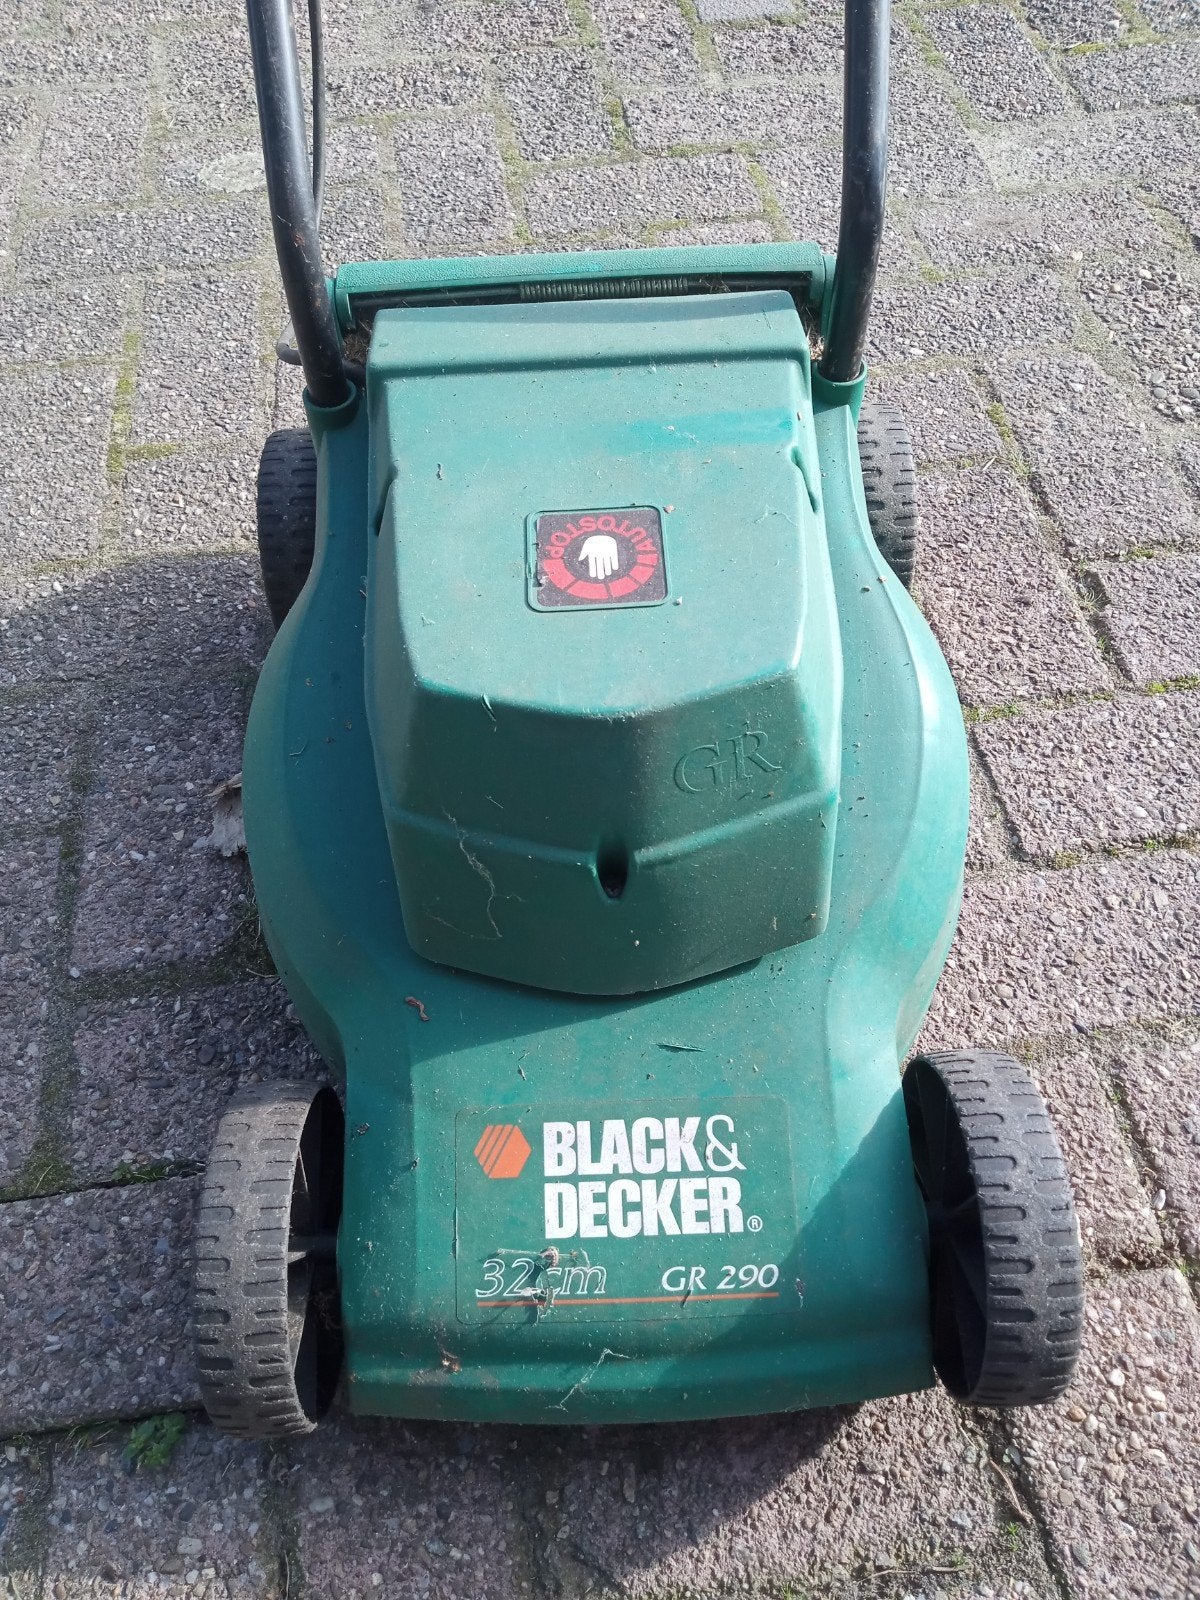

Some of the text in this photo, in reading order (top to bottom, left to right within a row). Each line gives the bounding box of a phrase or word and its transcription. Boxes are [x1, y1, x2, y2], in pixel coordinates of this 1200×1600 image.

[544, 515, 657, 558] AUTOSTOP
[673, 730, 782, 794] GR
[661, 1263, 780, 1292] GR 290
